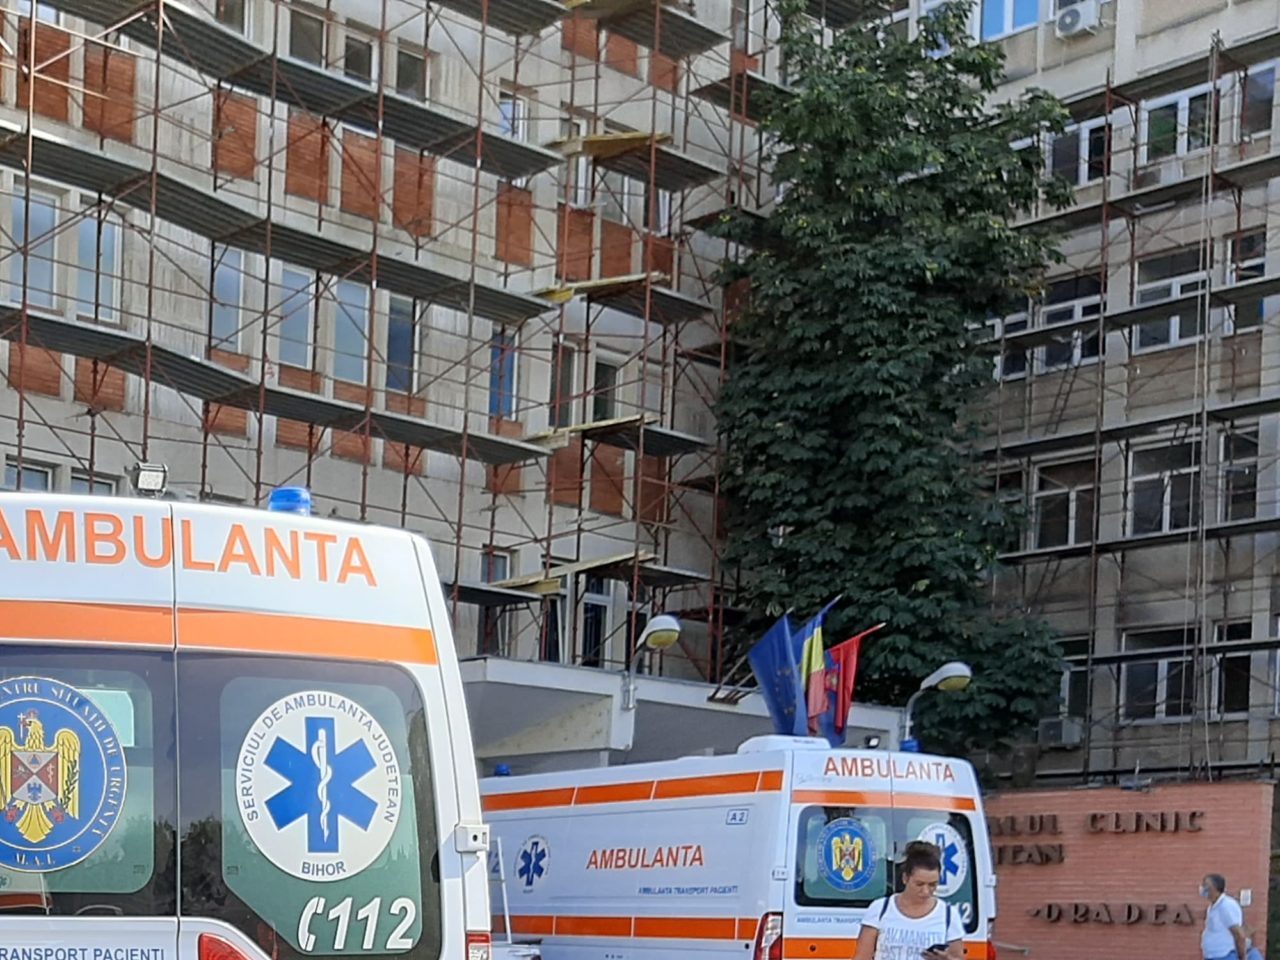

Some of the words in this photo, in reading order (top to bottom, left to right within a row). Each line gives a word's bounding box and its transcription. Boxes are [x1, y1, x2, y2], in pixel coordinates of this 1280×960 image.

[240, 731, 266, 822] SERVICIUL
[263, 707, 284, 730] DE
[284, 693, 373, 732] AMBULANTA
[372, 732, 400, 823] JUDETEAN
[823, 756, 956, 782] AMBULANTA
[1088, 810, 1207, 834] CLINIC
[301, 861, 347, 877] BIHOR
[586, 845, 704, 870] AMBULANTA
[327, 896, 417, 950] 112
